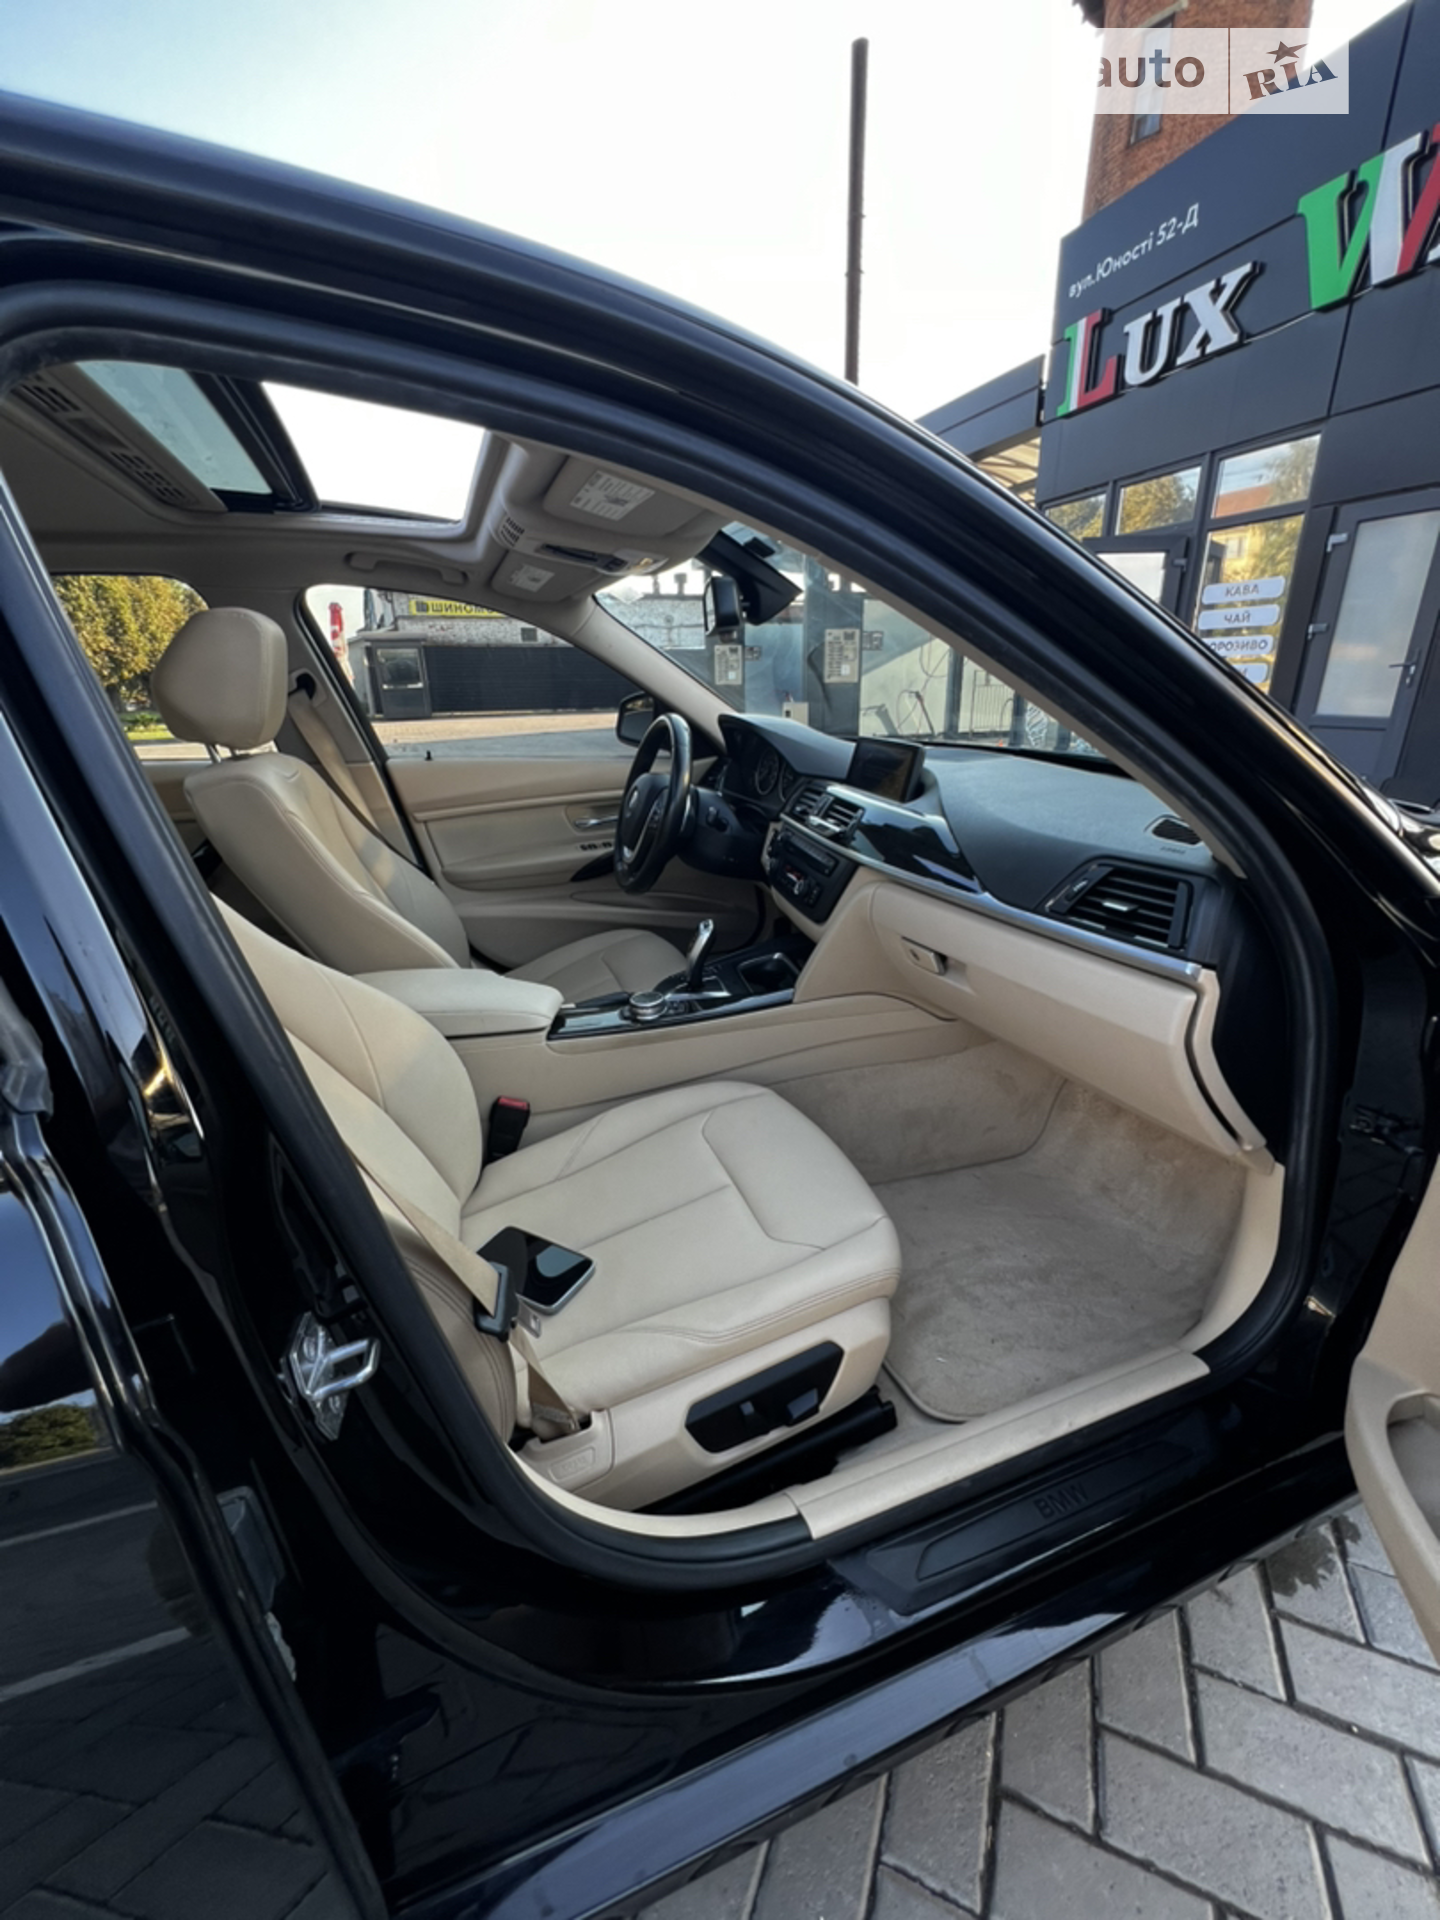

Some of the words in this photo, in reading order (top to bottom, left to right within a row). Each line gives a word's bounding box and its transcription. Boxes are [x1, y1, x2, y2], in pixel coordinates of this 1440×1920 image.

[1156, 203, 1199, 246] 52-Д
[1056, 261, 1257, 417] LUX
[1225, 584, 1259, 597] КАВА
[1224, 610, 1251, 624] ЧАЙ
[1209, 639, 1268, 651] ОРОЗИВО
[1034, 1481, 1089, 1518] BMW
